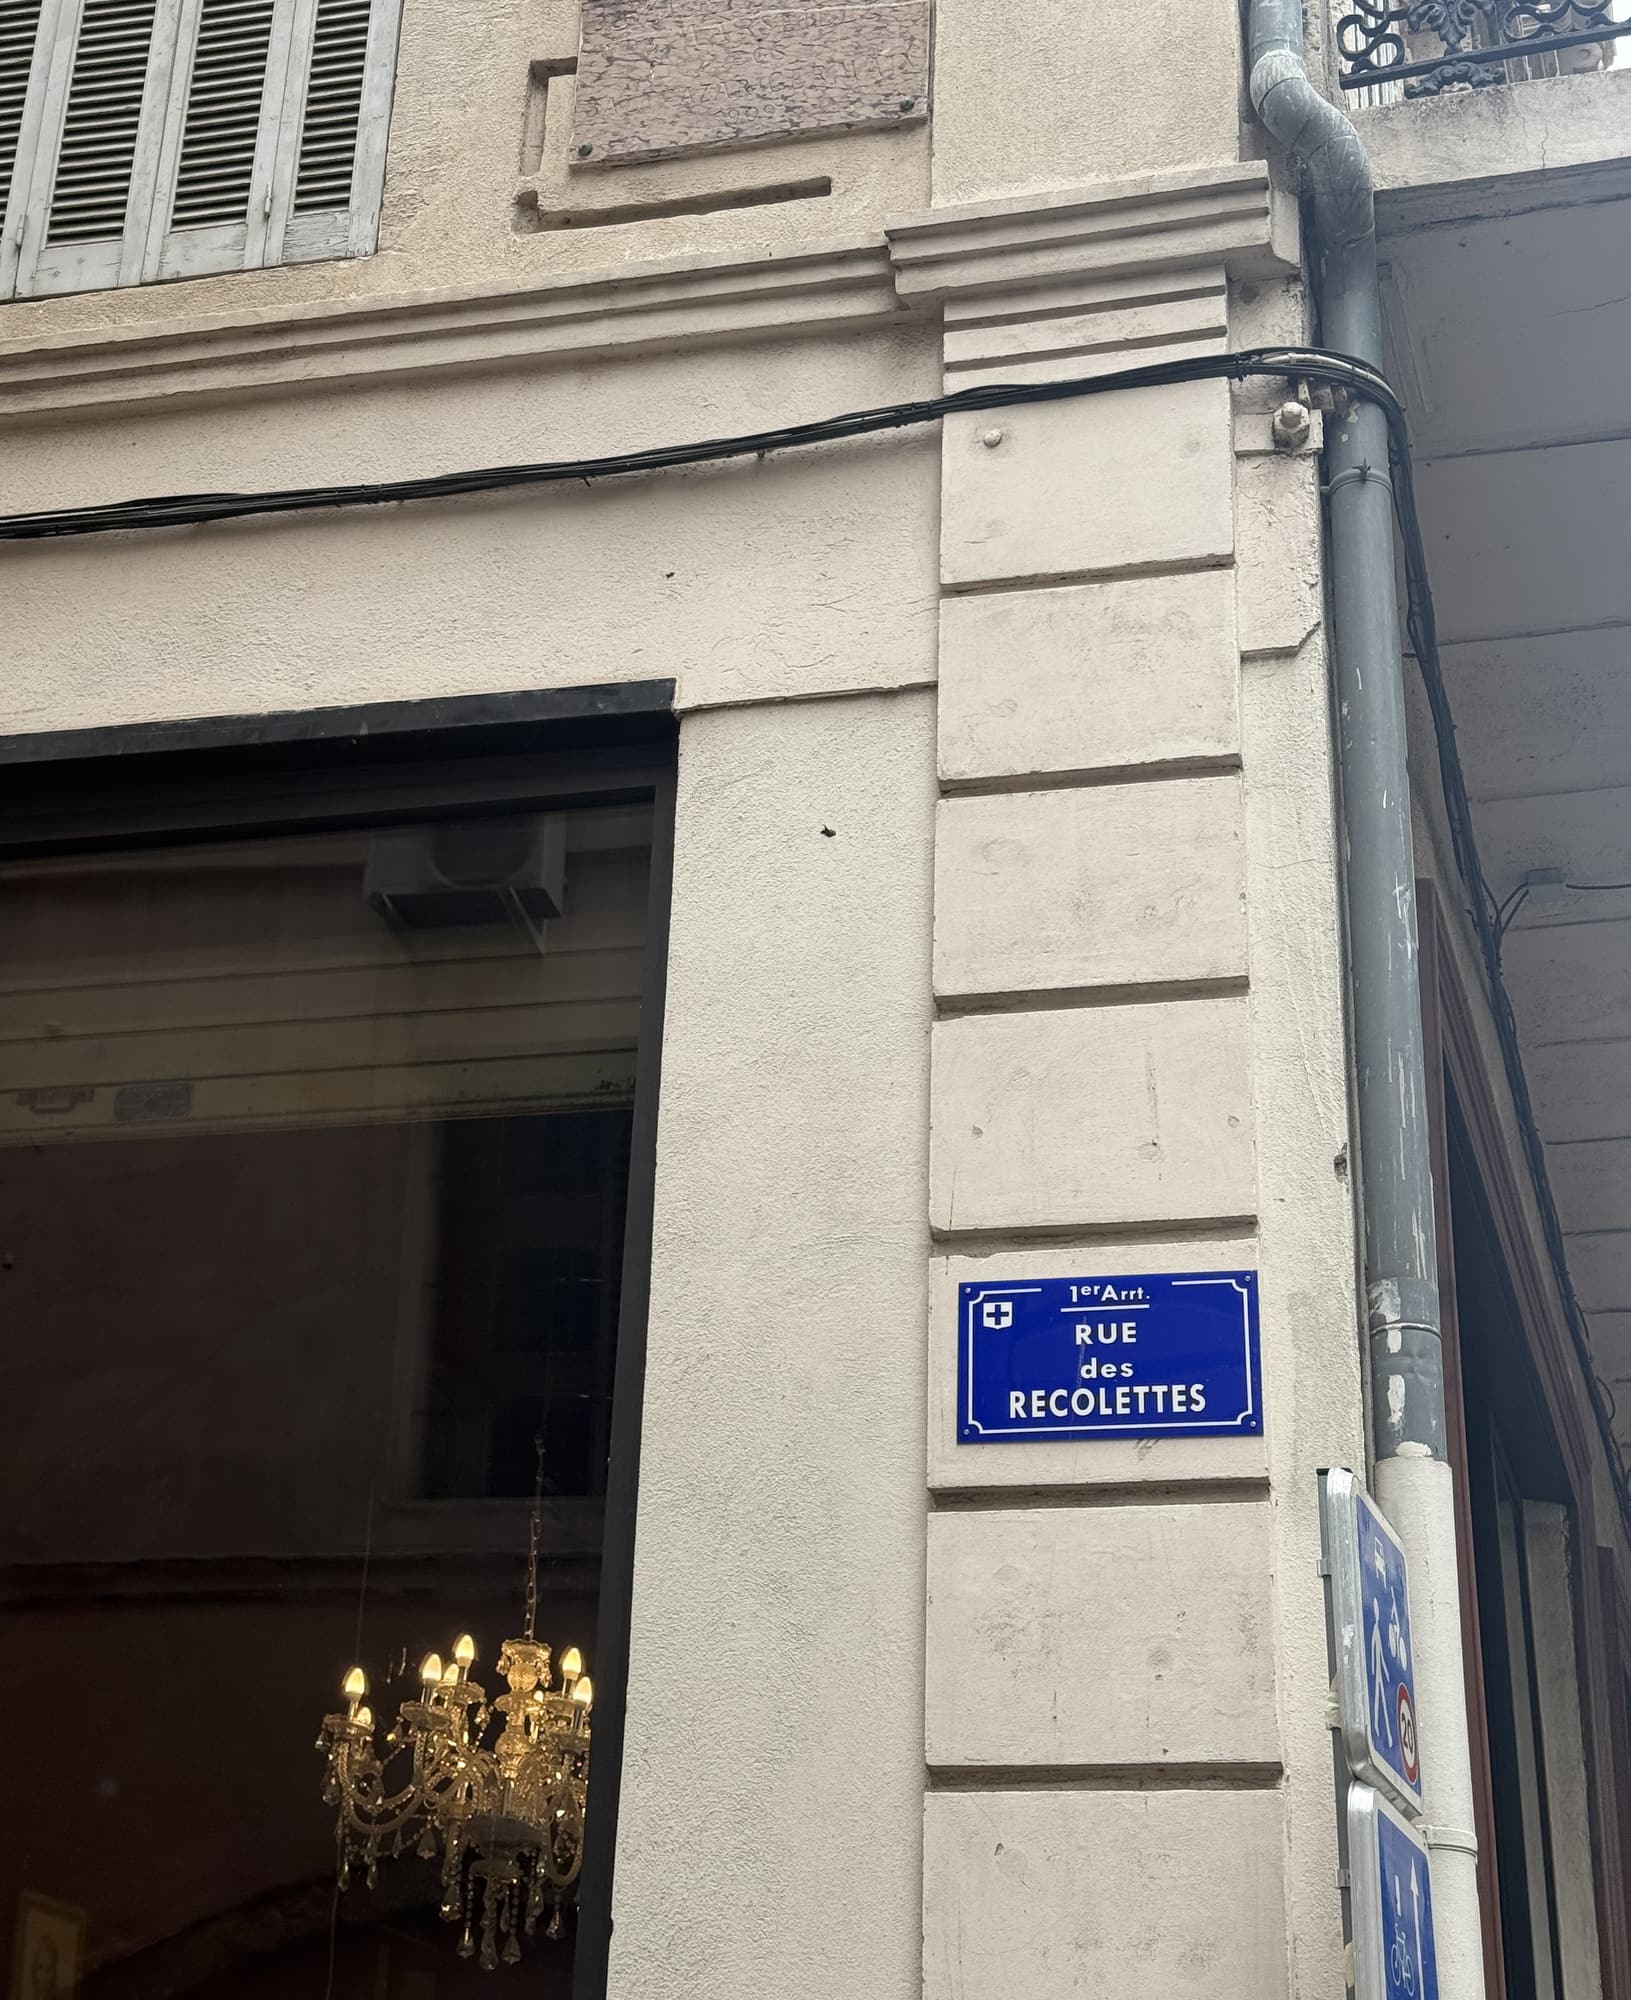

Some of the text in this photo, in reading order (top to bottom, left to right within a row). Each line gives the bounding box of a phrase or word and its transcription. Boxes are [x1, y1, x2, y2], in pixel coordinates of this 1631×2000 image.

[1075, 1321, 1137, 1345] RUE
[1080, 1357, 1134, 1379] des
[1009, 1383, 1206, 1419] RECOLETTES
[1401, 1712, 1413, 1754] 20
